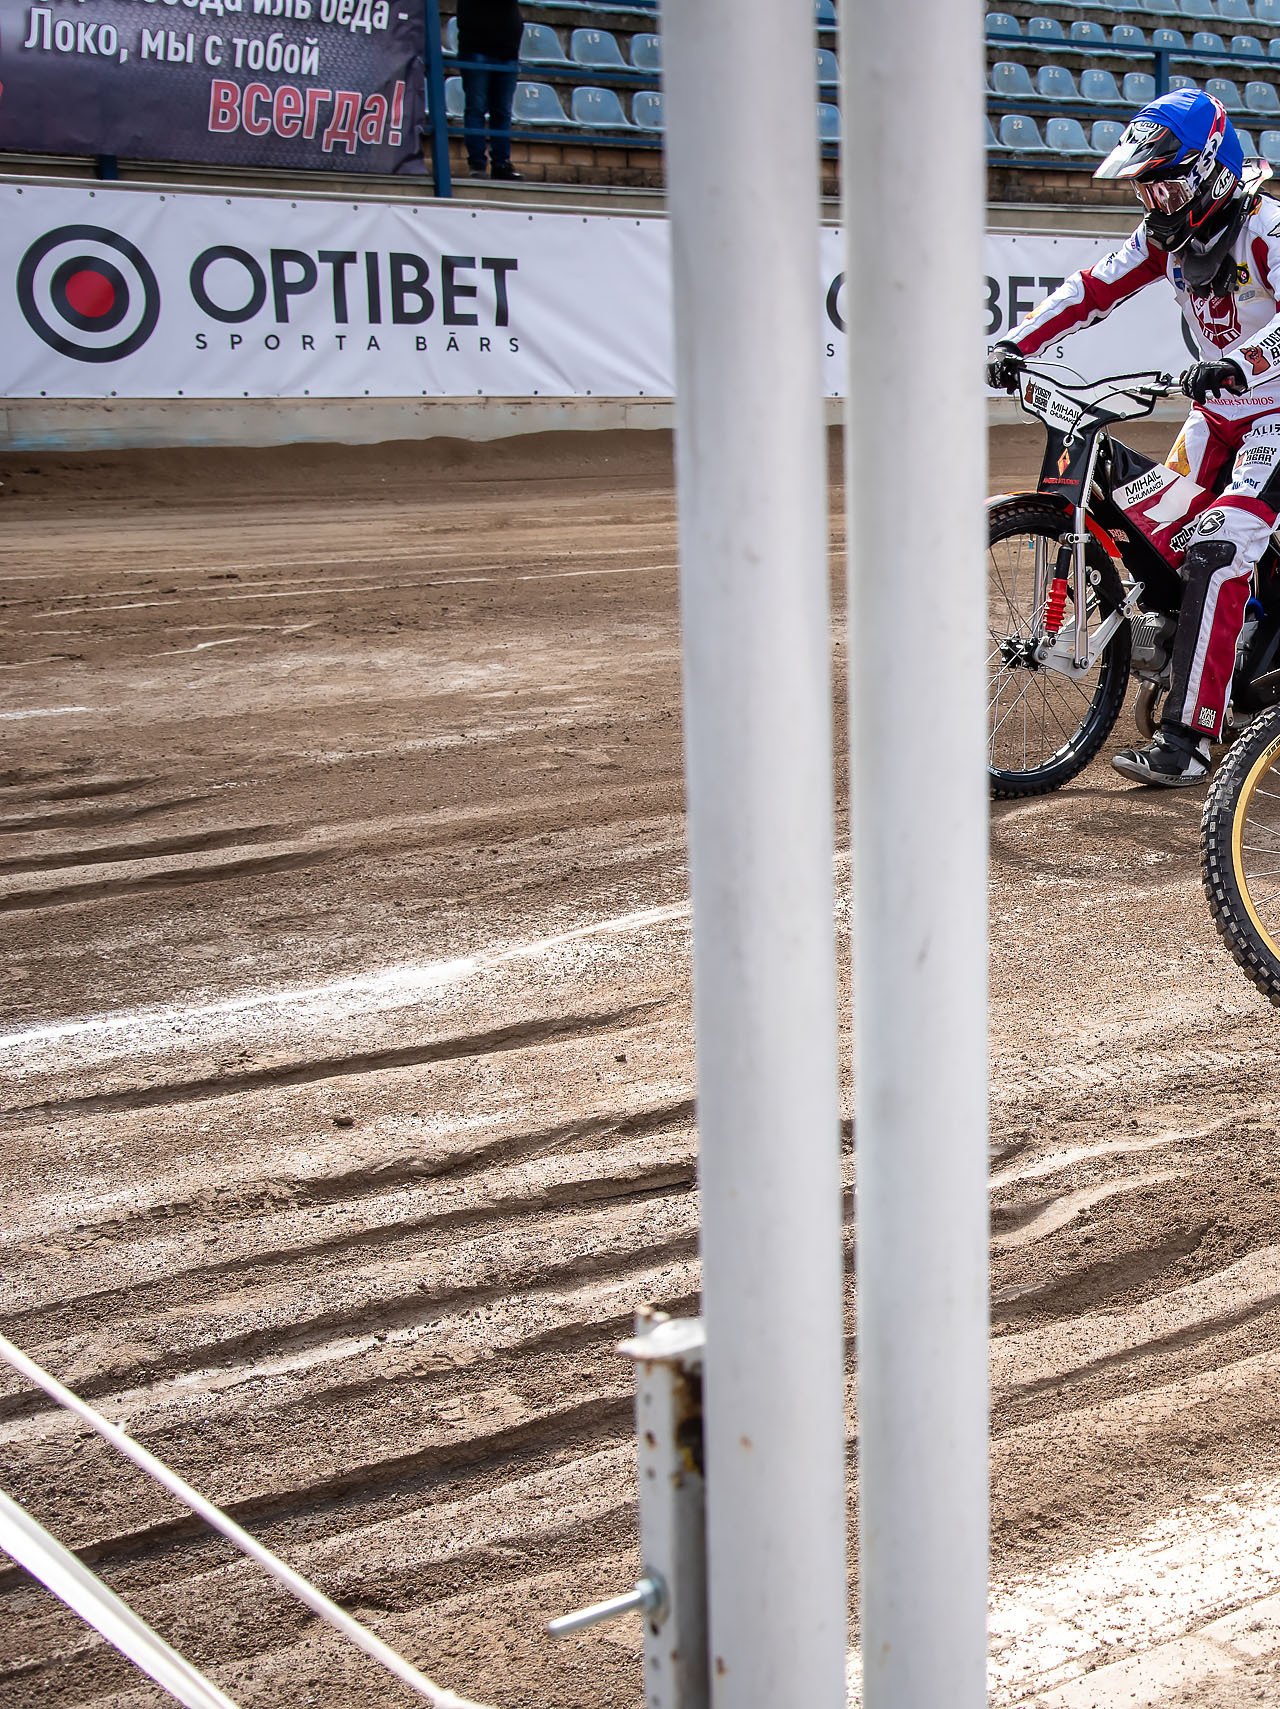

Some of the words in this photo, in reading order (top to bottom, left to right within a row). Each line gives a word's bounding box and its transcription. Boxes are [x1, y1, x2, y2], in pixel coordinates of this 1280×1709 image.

[24, 7, 129, 64] Локо,
[140, 28, 195, 63] мы
[204, 34, 223, 66] с
[233, 33, 321, 76] тобой
[208, 79, 406, 154] всегда!
[190, 245, 519, 327] OPTIBET
[195, 333, 381, 353] SPORTA
[415, 332, 520, 354] BĀRS
[1235, 396, 1275, 407] STUDIOS
[1124, 470, 1162, 497] MIHAIL
[1127, 479, 1165, 506] CHUMAKOV
